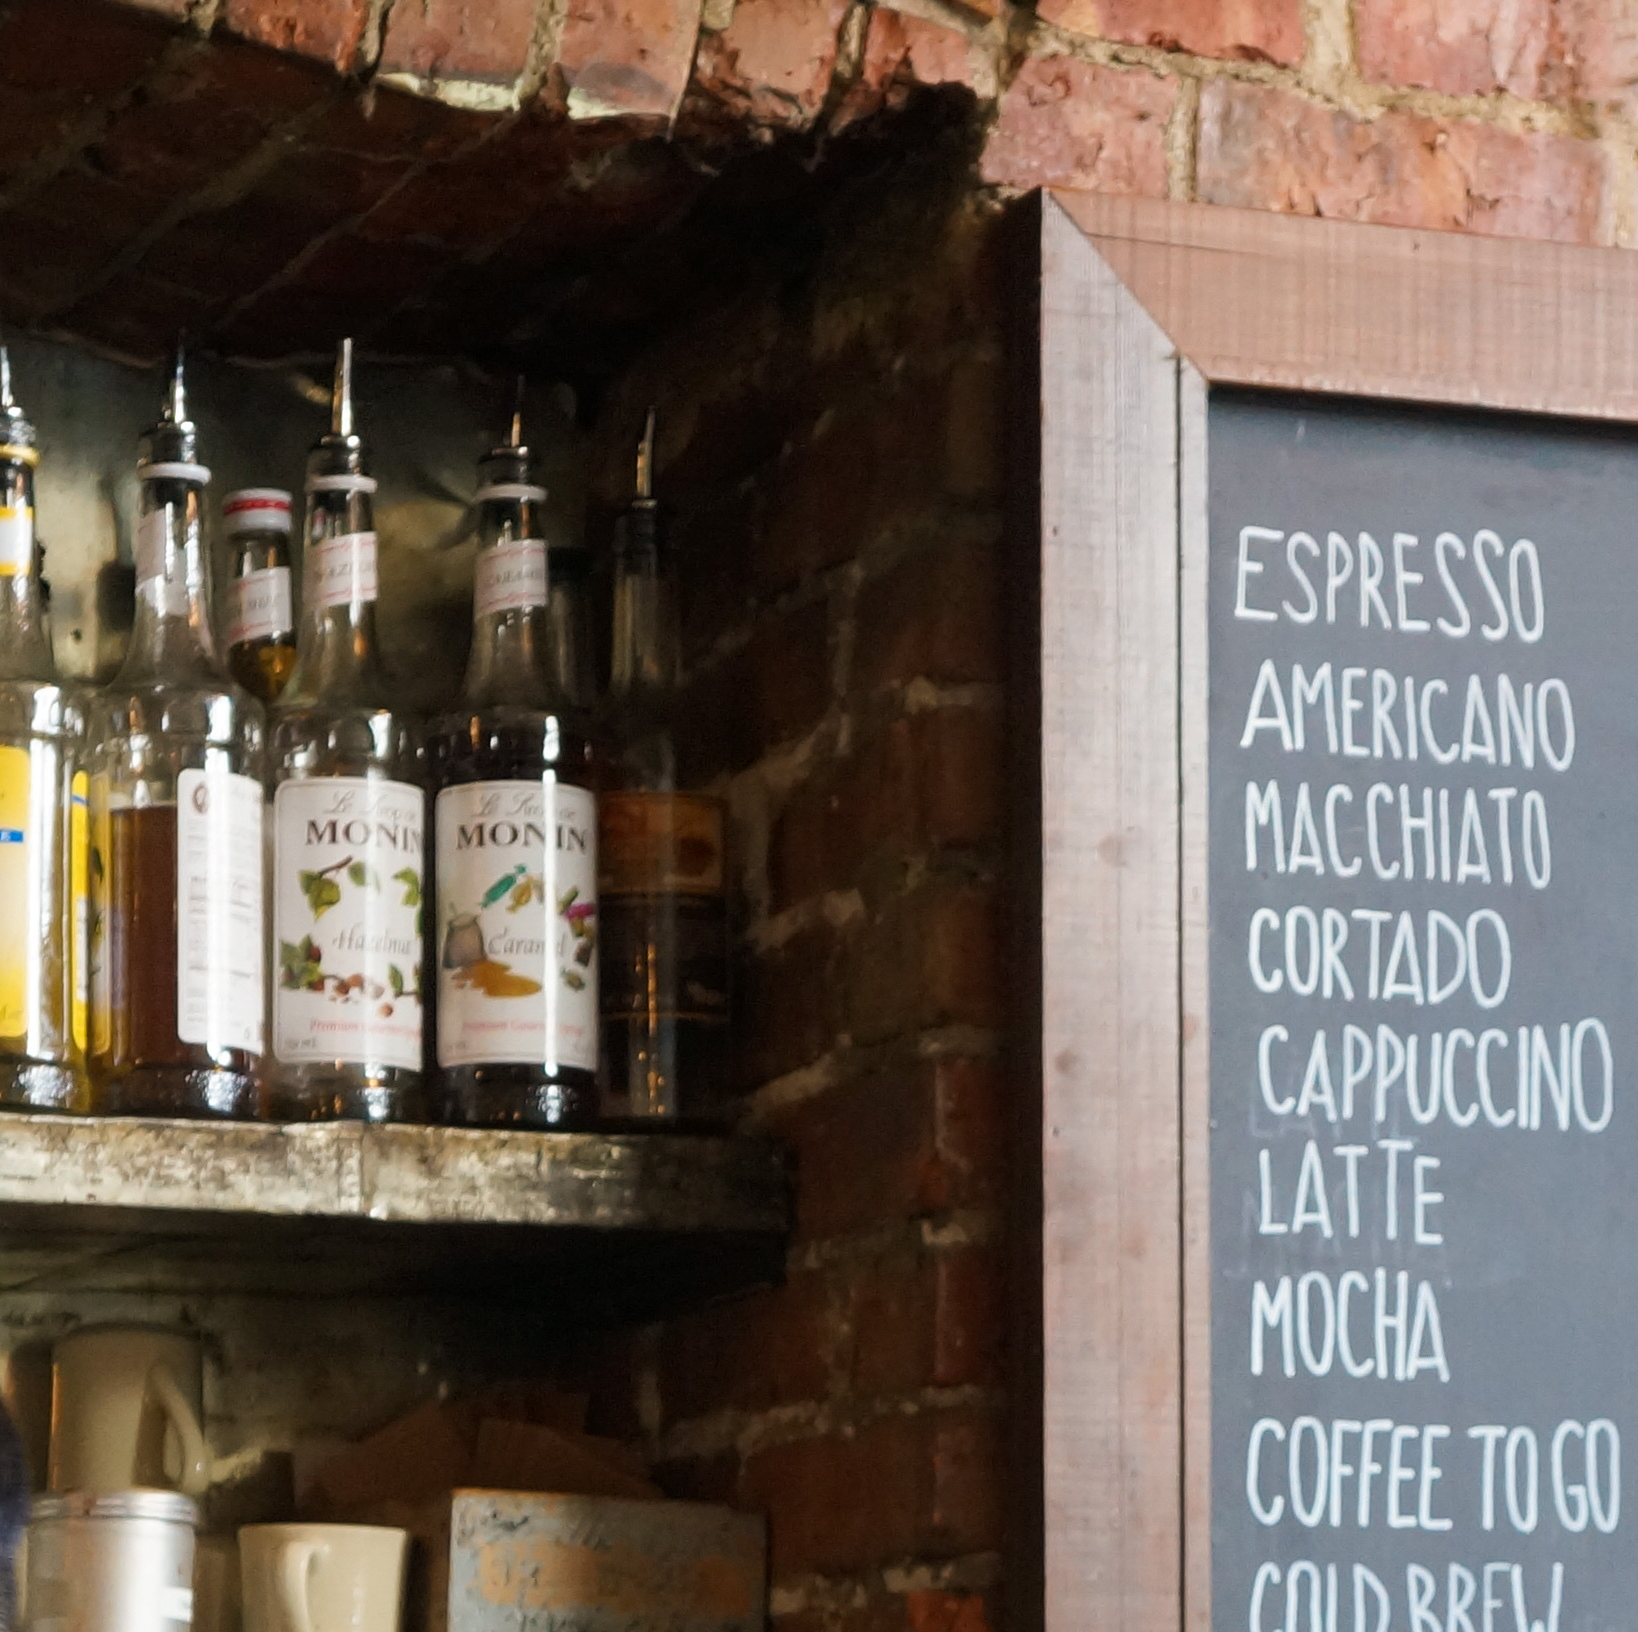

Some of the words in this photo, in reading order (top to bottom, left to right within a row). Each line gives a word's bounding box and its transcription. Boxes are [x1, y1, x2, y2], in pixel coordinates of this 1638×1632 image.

[1234, 525, 1544, 642] ESPRESSO
[1239, 658, 1576, 771] AMERICANO
[456, 819, 588, 853] MONIN
[1245, 779, 1551, 890] MACCHIATO
[1248, 906, 1511, 1009] CORTADO
[1258, 1016, 1614, 1133] CAPPUCCINO
[1258, 1139, 1445, 1245] LATTE
[1250, 1267, 1451, 1382] MOCHA
[1246, 1416, 1454, 1531] COFFEE
[1468, 1424, 1538, 1534] TO
[1551, 1418, 1621, 1533] GO
